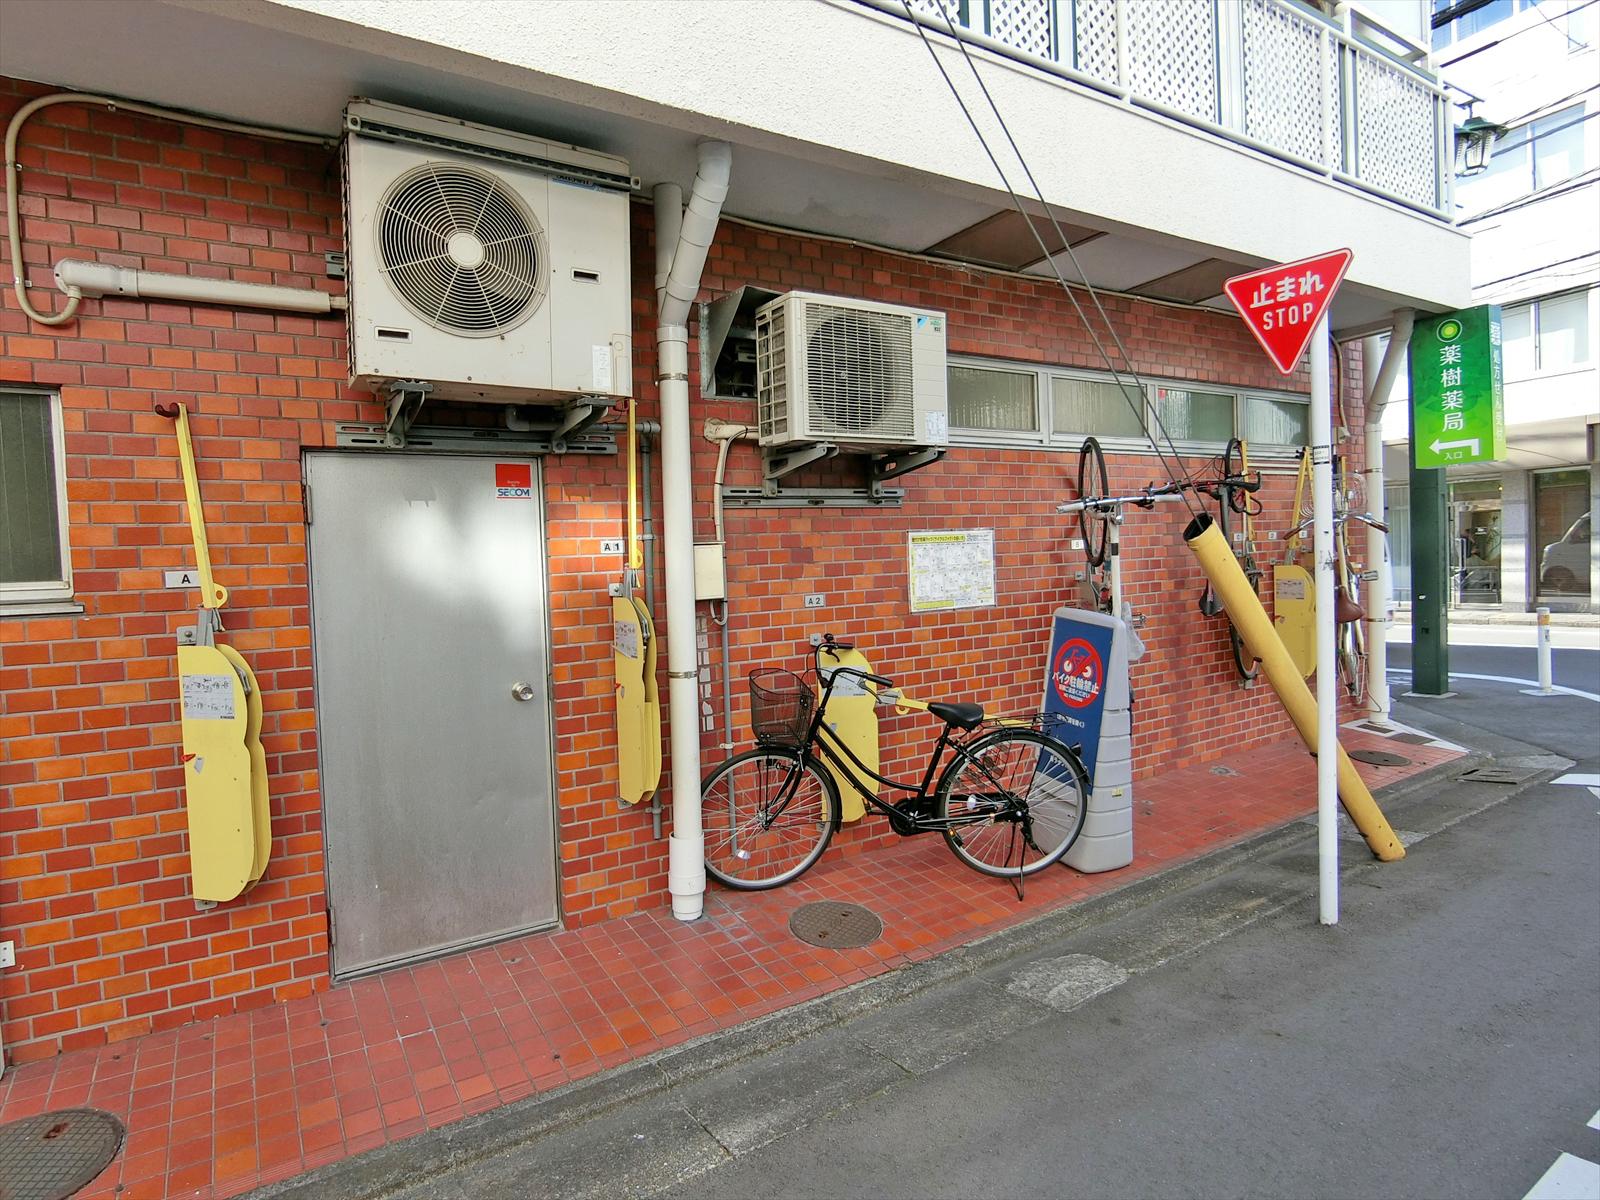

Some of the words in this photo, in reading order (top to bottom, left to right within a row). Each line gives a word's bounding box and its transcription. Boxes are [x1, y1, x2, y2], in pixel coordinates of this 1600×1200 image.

[1250, 271, 1324, 308] 止まれ
[1263, 303, 1313, 330] STOP
[1440, 344, 1464, 432] 薬樹薬局
[1444, 452, 1462, 460] 入口
[498, 488, 530, 497] SECOM
[181, 574, 191, 584] A
[1052, 671, 1099, 695] バイク駐輪禁止
